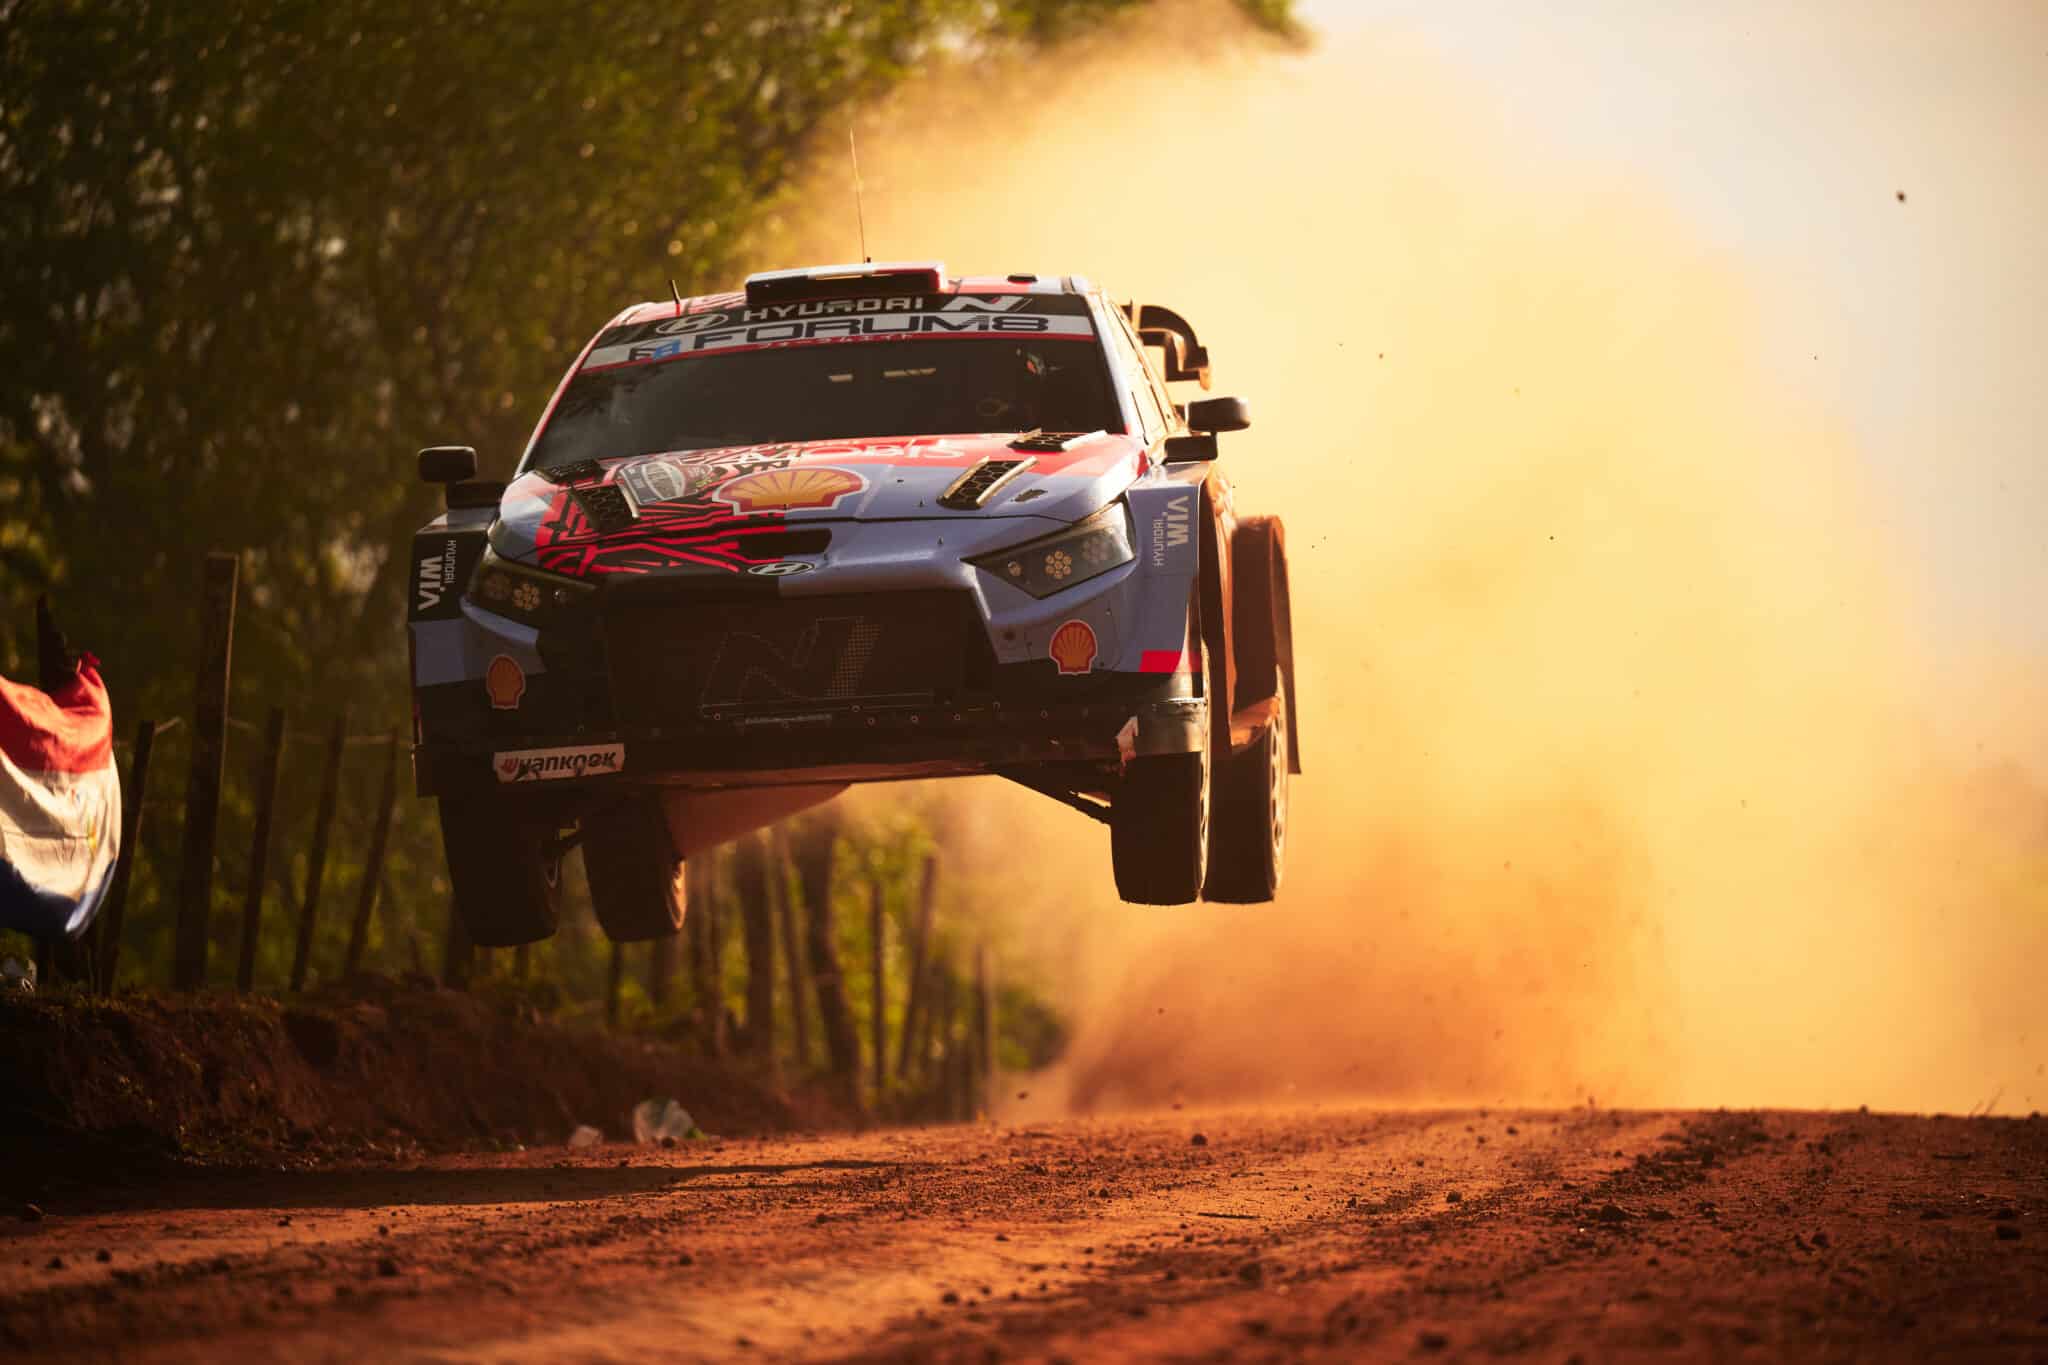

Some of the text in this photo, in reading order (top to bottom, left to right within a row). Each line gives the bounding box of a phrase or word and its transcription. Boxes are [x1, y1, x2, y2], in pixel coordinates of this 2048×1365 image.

[693, 314, 1049, 350] FORUM8
[743, 296, 924, 322] HYUNDAI
[1151, 518, 1165, 568] HYUNDAI
[1162, 495, 1189, 547] WIA
[417, 554, 446, 611] WIA
